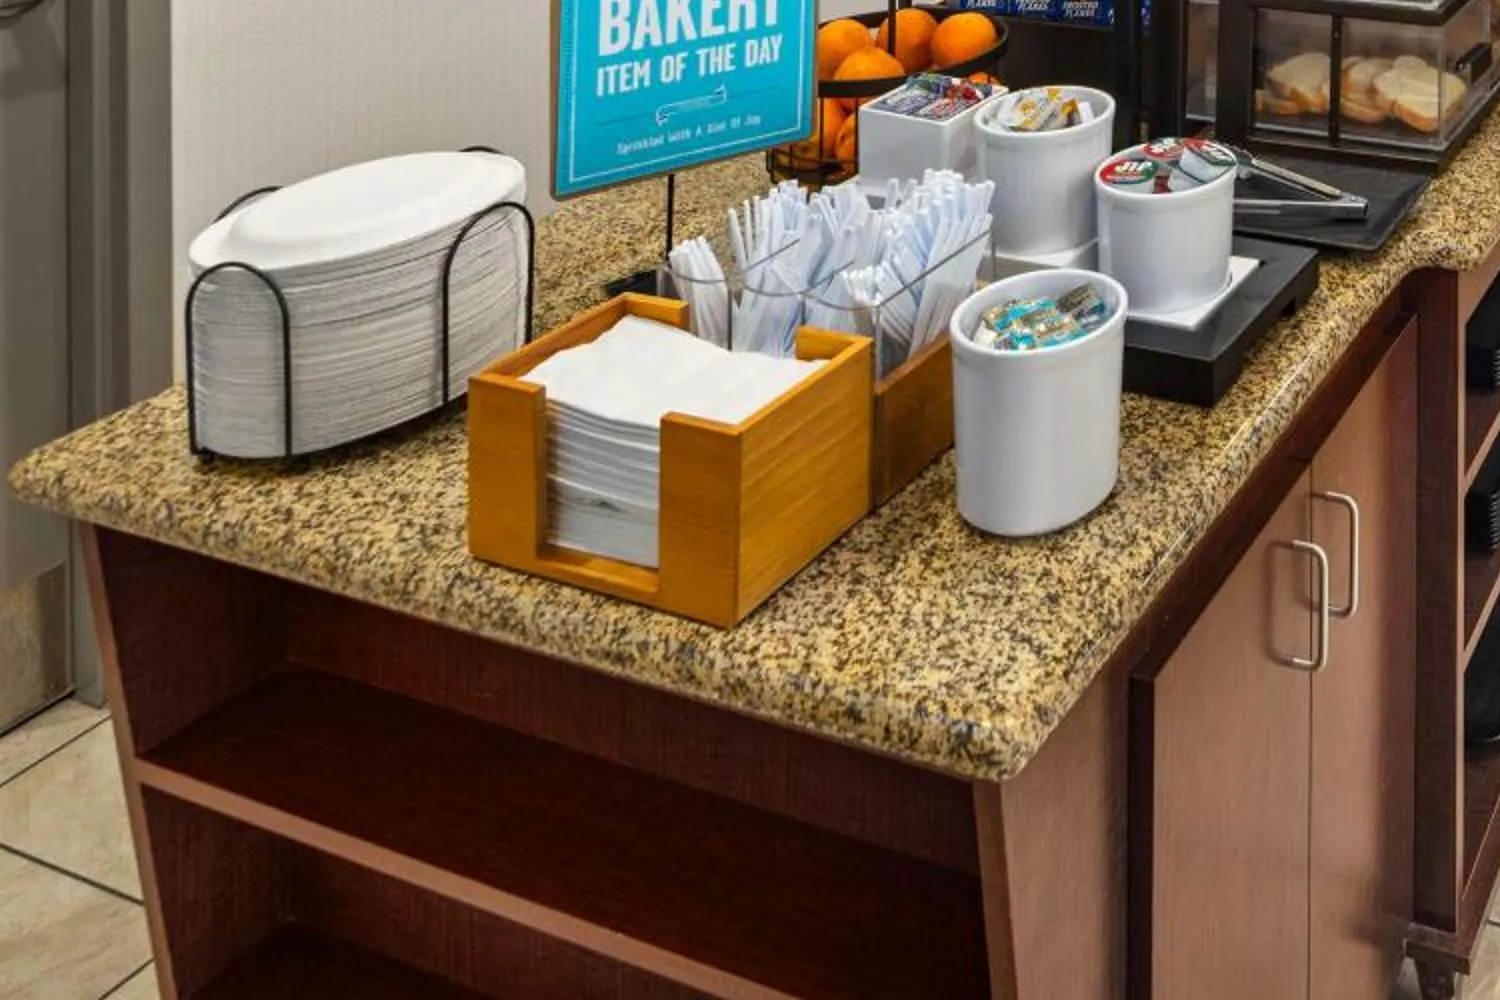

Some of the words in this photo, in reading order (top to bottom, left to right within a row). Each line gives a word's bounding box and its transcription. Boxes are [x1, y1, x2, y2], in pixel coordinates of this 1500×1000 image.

[596, 58, 652, 97] ITEM
[660, 52, 689, 84] OF
[696, 43, 737, 77] THE
[744, 34, 784, 68] DAY
